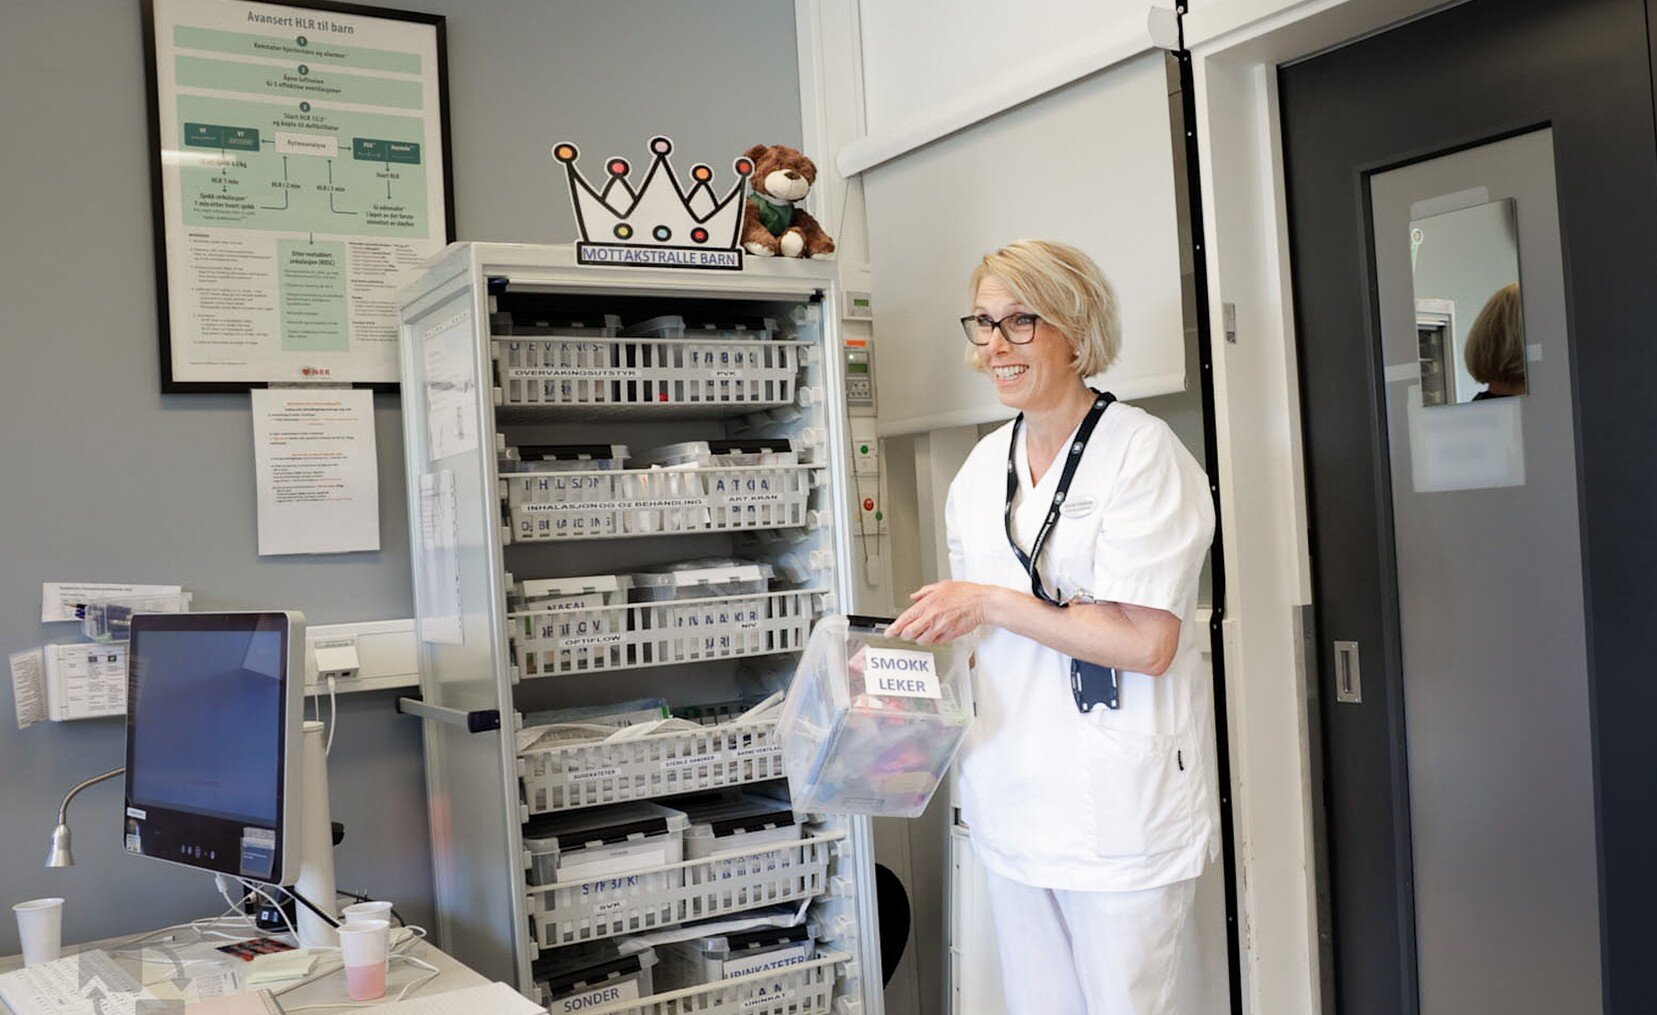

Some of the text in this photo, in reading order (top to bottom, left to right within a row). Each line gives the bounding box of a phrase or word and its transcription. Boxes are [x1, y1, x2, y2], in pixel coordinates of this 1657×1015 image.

[247, 10, 355, 35] Avansert HLR til barn
[582, 246, 737, 266] MOTTAKSTRALLE BARN
[564, 633, 622, 646] OPTIFLOW
[870, 656, 930, 673] SMOKK
[879, 677, 927, 693] LEKER
[563, 987, 620, 1013] SONDER
